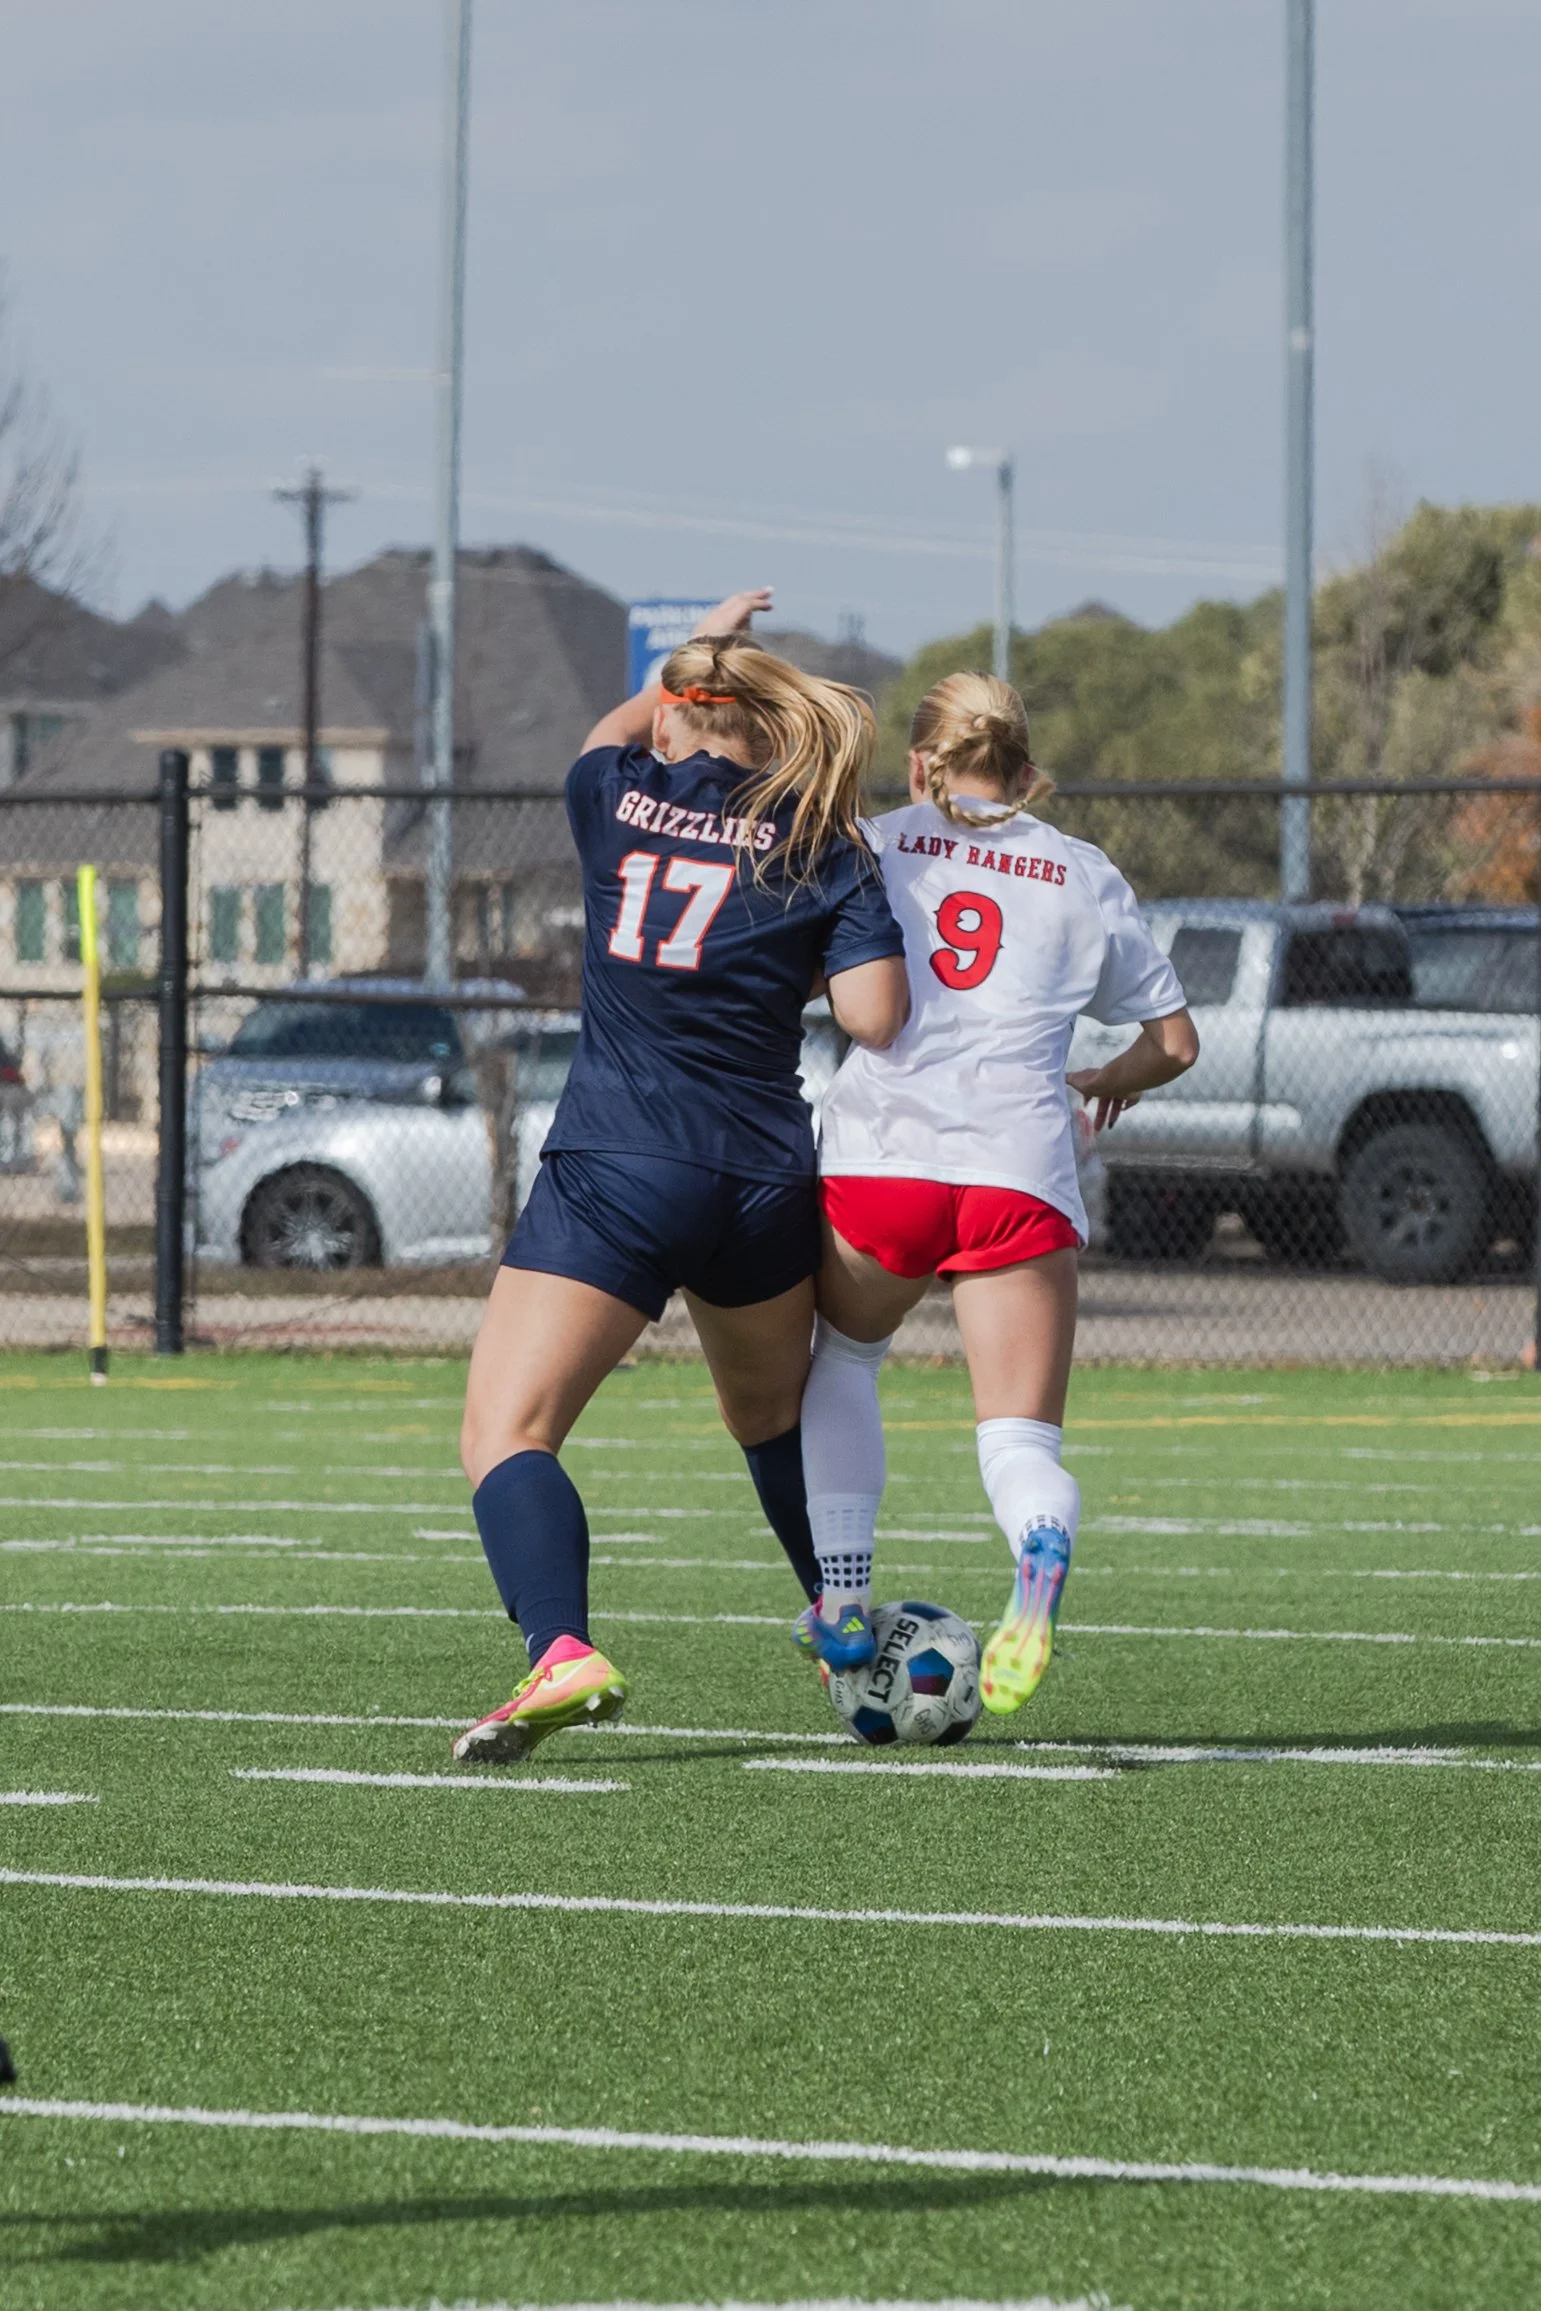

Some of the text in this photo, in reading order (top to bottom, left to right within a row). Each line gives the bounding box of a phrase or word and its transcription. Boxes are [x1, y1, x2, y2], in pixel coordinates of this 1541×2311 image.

[616, 790, 776, 851] GRIZZLIES
[897, 832, 1067, 886] LADY RANGERS
[608, 850, 737, 971] 17
[929, 890, 1005, 991] 9
[867, 1617, 920, 1704] SELECT
